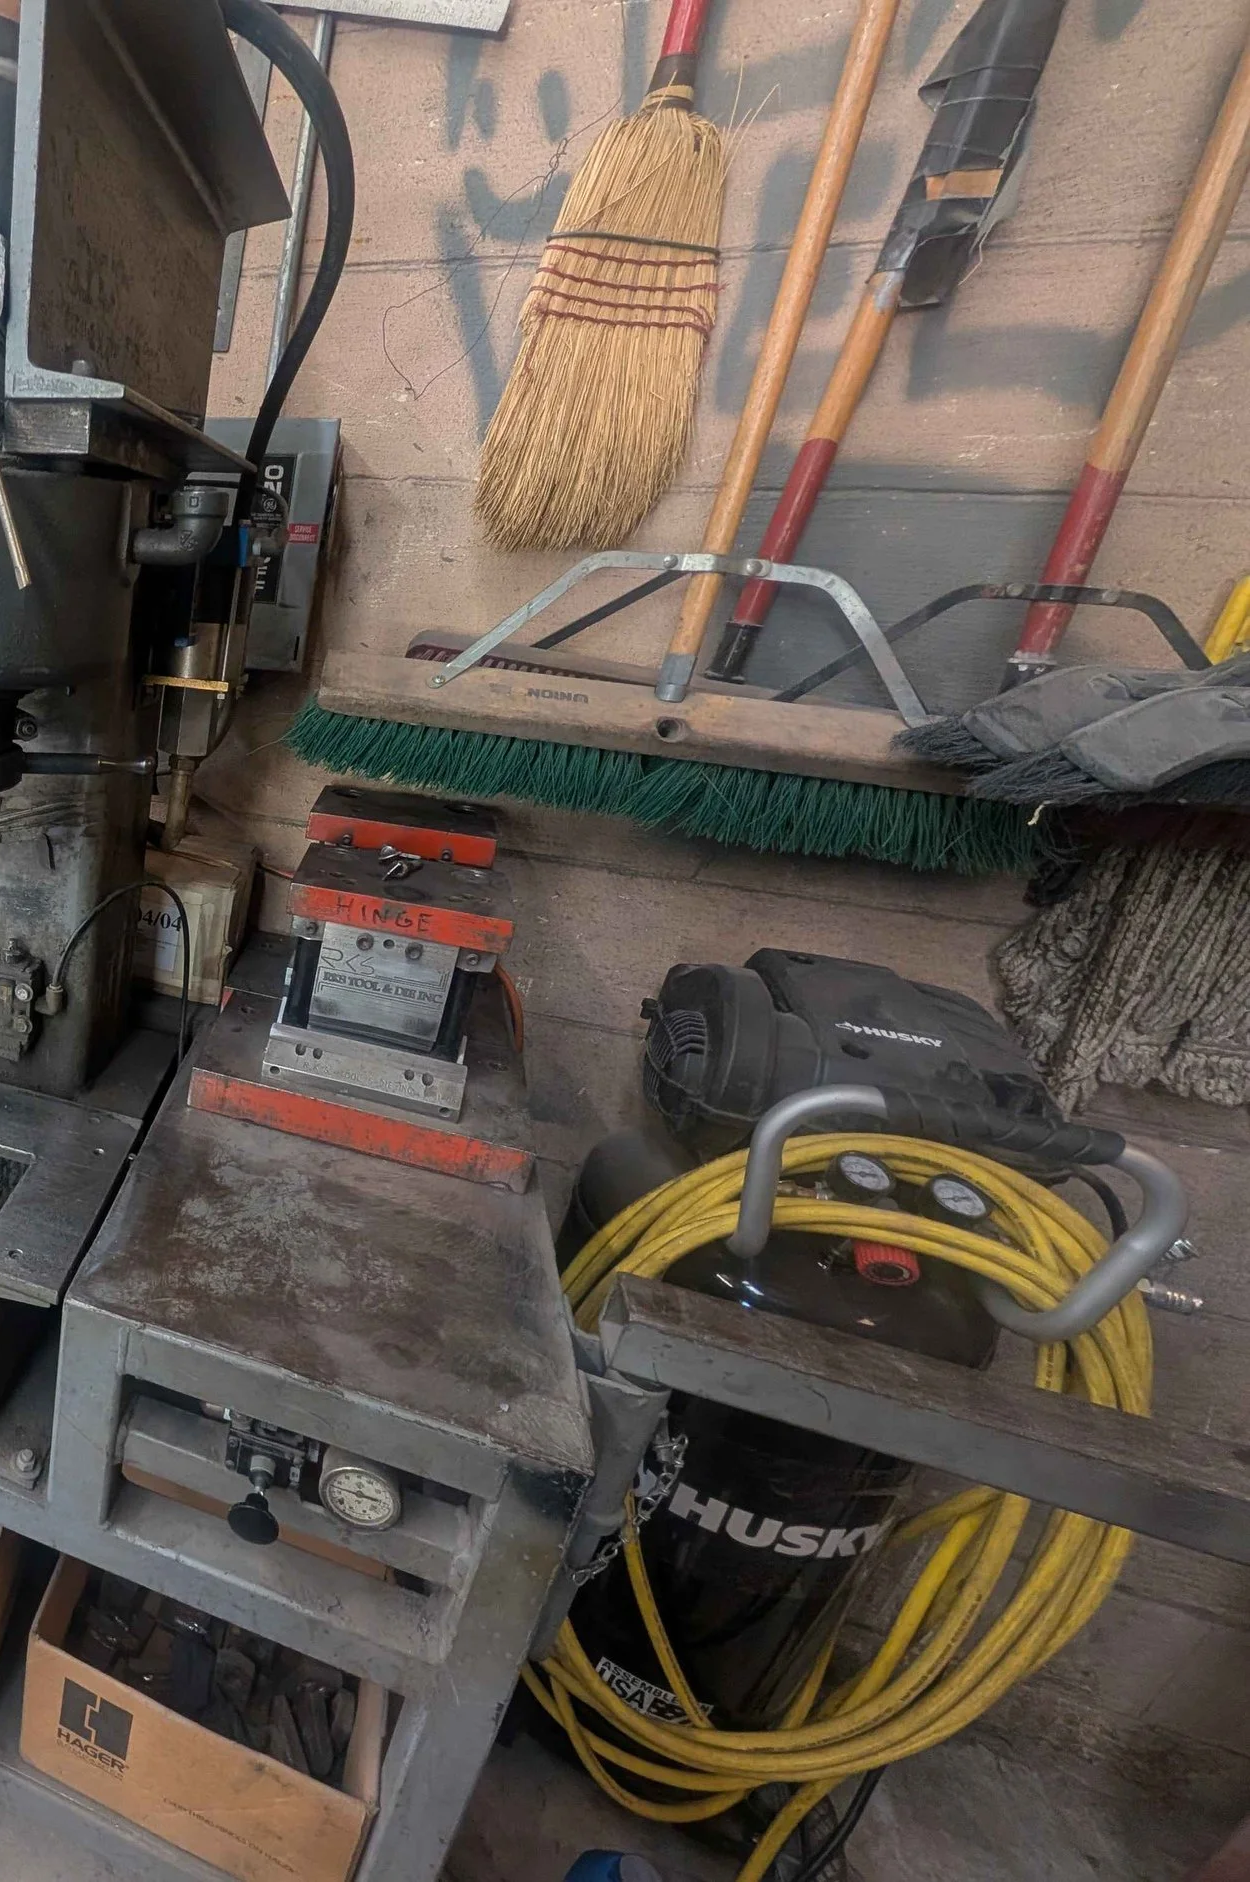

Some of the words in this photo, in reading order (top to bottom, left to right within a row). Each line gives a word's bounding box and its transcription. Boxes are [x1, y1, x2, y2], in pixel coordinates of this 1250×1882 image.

[294, 525, 312, 534] SERVICE
[527, 687, 589, 704] UNION
[336, 896, 435, 932] HINGE
[348, 976, 382, 993] TOOL
[382, 984, 393, 994] &
[862, 1025, 943, 1047] HUSKY
[56, 1727, 127, 1774] HAGER
